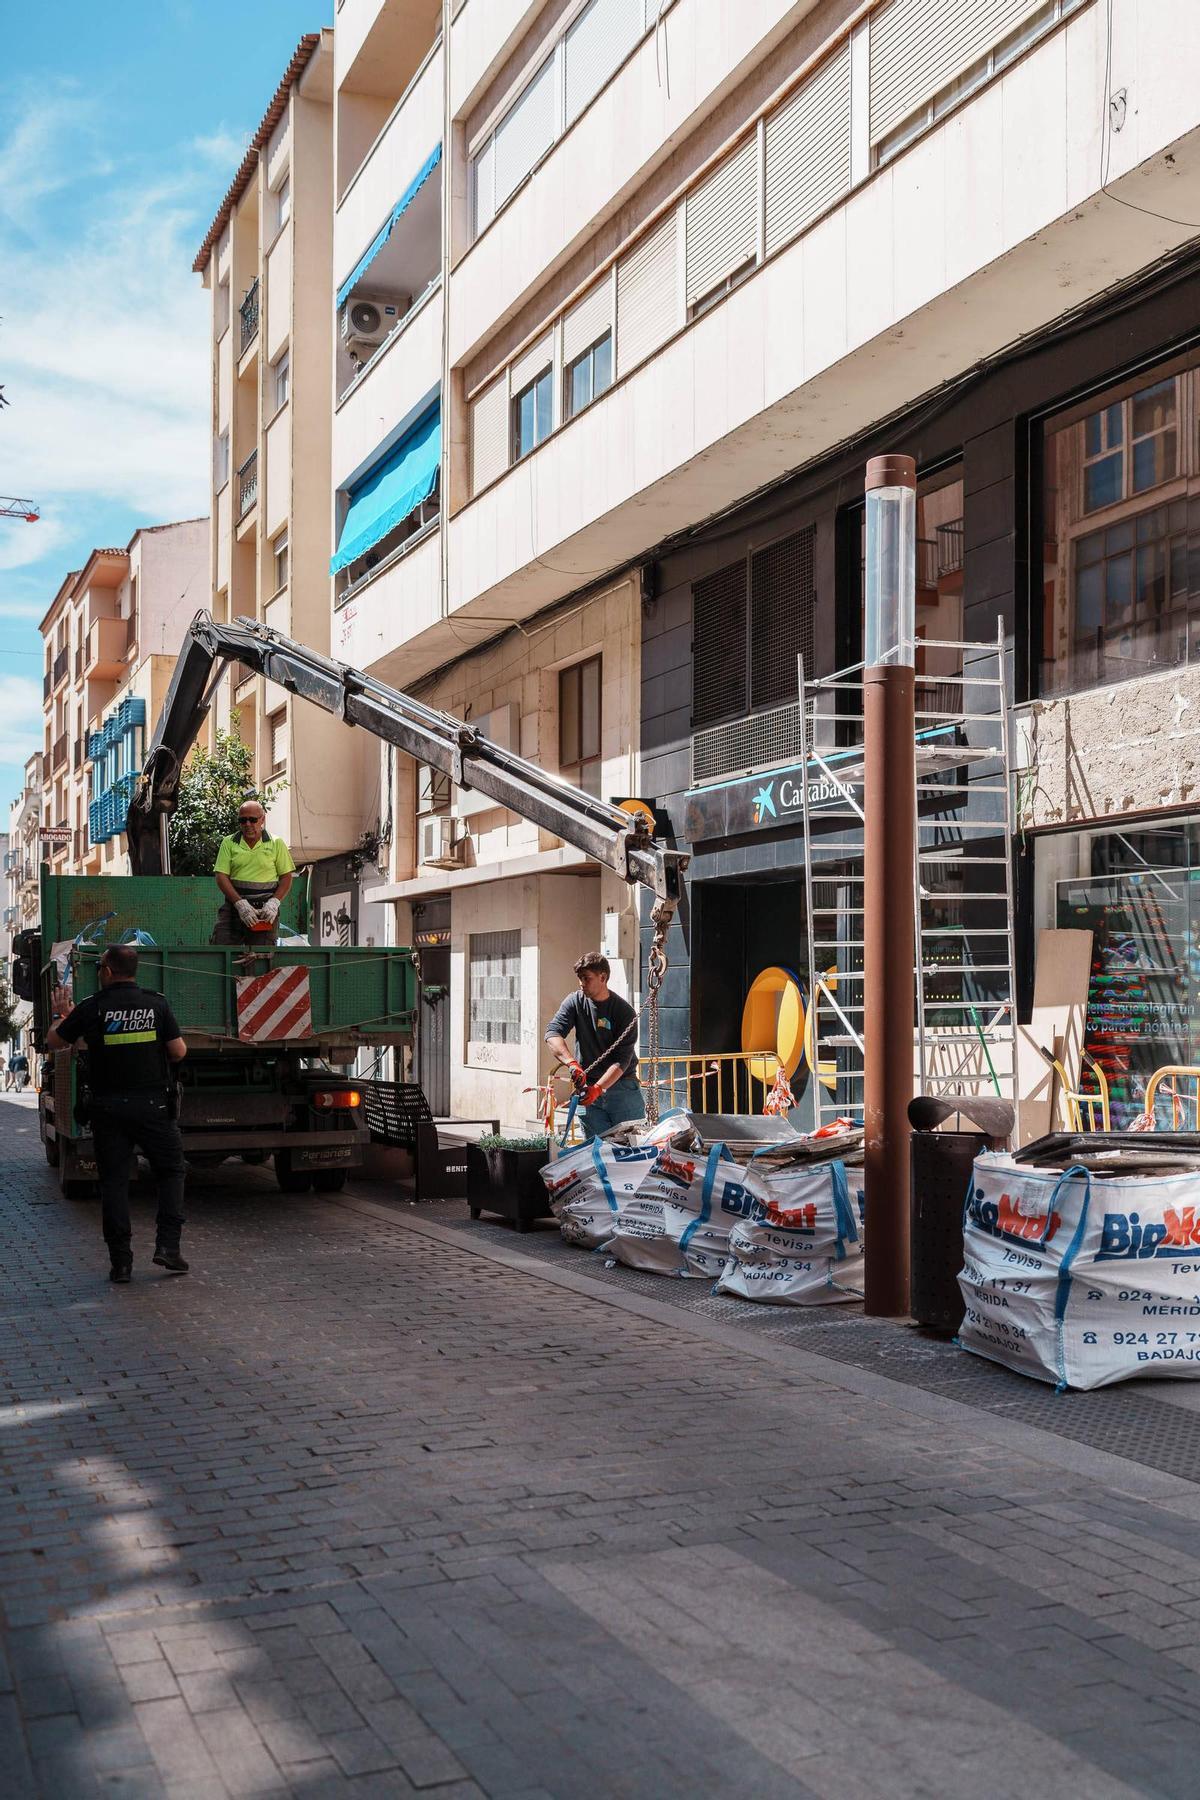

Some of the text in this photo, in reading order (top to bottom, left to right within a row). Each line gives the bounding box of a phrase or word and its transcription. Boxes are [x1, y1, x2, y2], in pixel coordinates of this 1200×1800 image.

[104, 1008, 155, 1023] POLICIA
[1143, 1002, 1176, 1018] elegir
[1180, 1004, 1195, 1015] un
[123, 1019, 156, 1031] LOCAL
[1101, 1022, 1126, 1035] para
[1129, 1022, 1141, 1033] tu
[964, 1188, 1062, 1243] igMat
[764, 1232, 814, 1251] Tevisa
[793, 1260, 812, 1272] 34
[1002, 1247, 1042, 1271] Tevisa
[1012, 1281, 1032, 1294] 31
[1118, 1290, 1152, 1301] 924
[1011, 1326, 1027, 1341] 34
[1113, 1331, 1150, 1346] 924
[1156, 1332, 1178, 1345] 27
